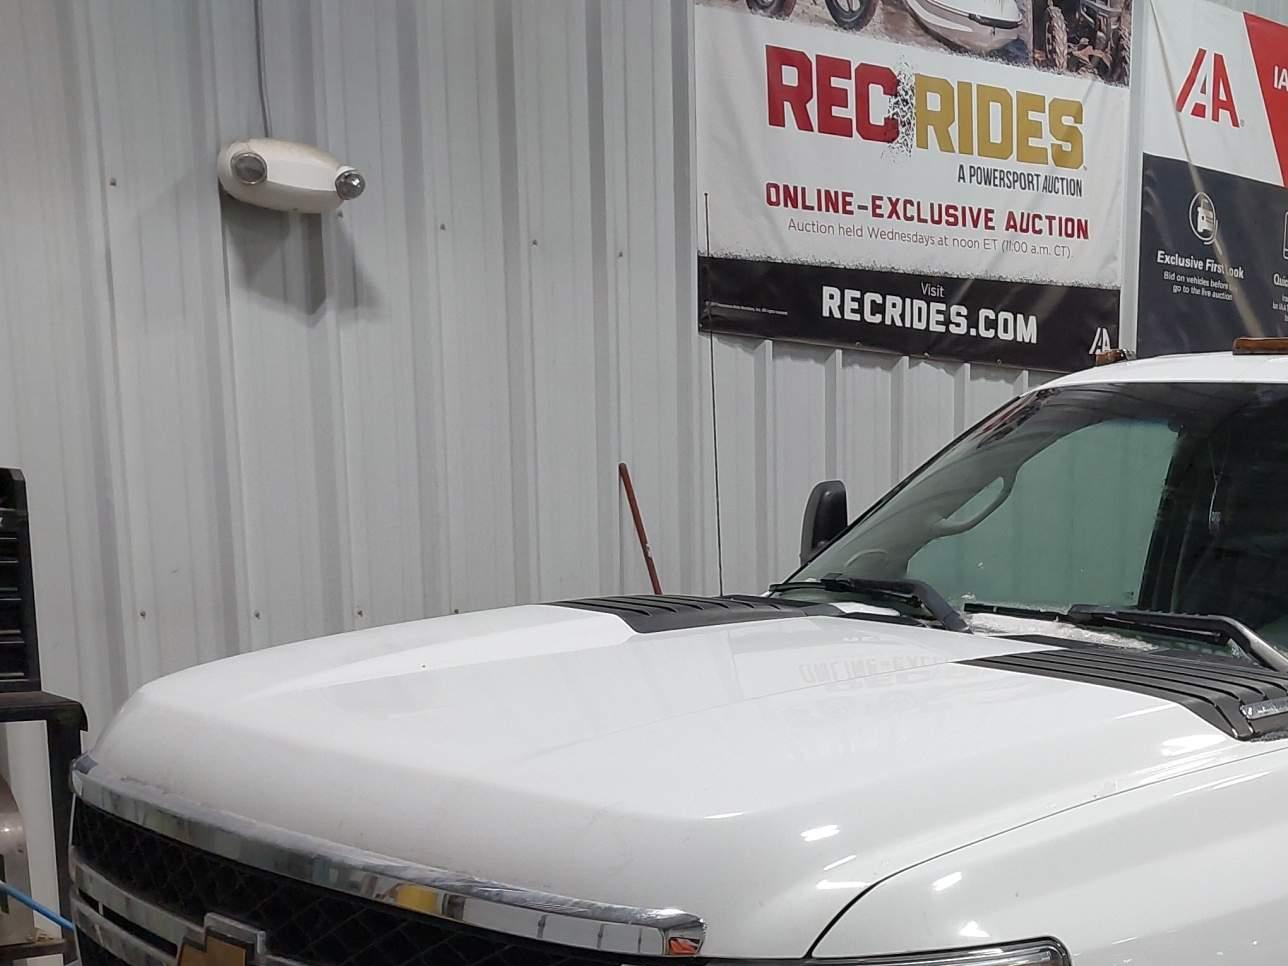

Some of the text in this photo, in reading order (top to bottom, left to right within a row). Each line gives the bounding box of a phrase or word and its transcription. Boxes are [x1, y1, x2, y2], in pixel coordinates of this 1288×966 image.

[957, 164, 1083, 198] A POWERSPORT AUCTION
[765, 182, 1090, 240] ONLINE-EXCLUSIVE AUCTION
[788, 218, 835, 235] Auction
[838, 224, 864, 238] held
[867, 226, 935, 247] Wednesdays
[937, 235, 949, 247] at
[952, 237, 980, 250] noon
[983, 239, 998, 251] ET
[1001, 239, 1028, 254] (11:00
[1157, 250, 1204, 271] Exclusive
[1205, 259, 1226, 275] First
[1163, 271, 1175, 281] Bid
[1176, 275, 1185, 283] on
[1187, 275, 1210, 287] vehicles
[1172, 284, 1182, 293] go
[1182, 285, 1190, 293] to
[1190, 286, 1200, 295] the
[821, 281, 1038, 344] Visit RECRIDES.COM
